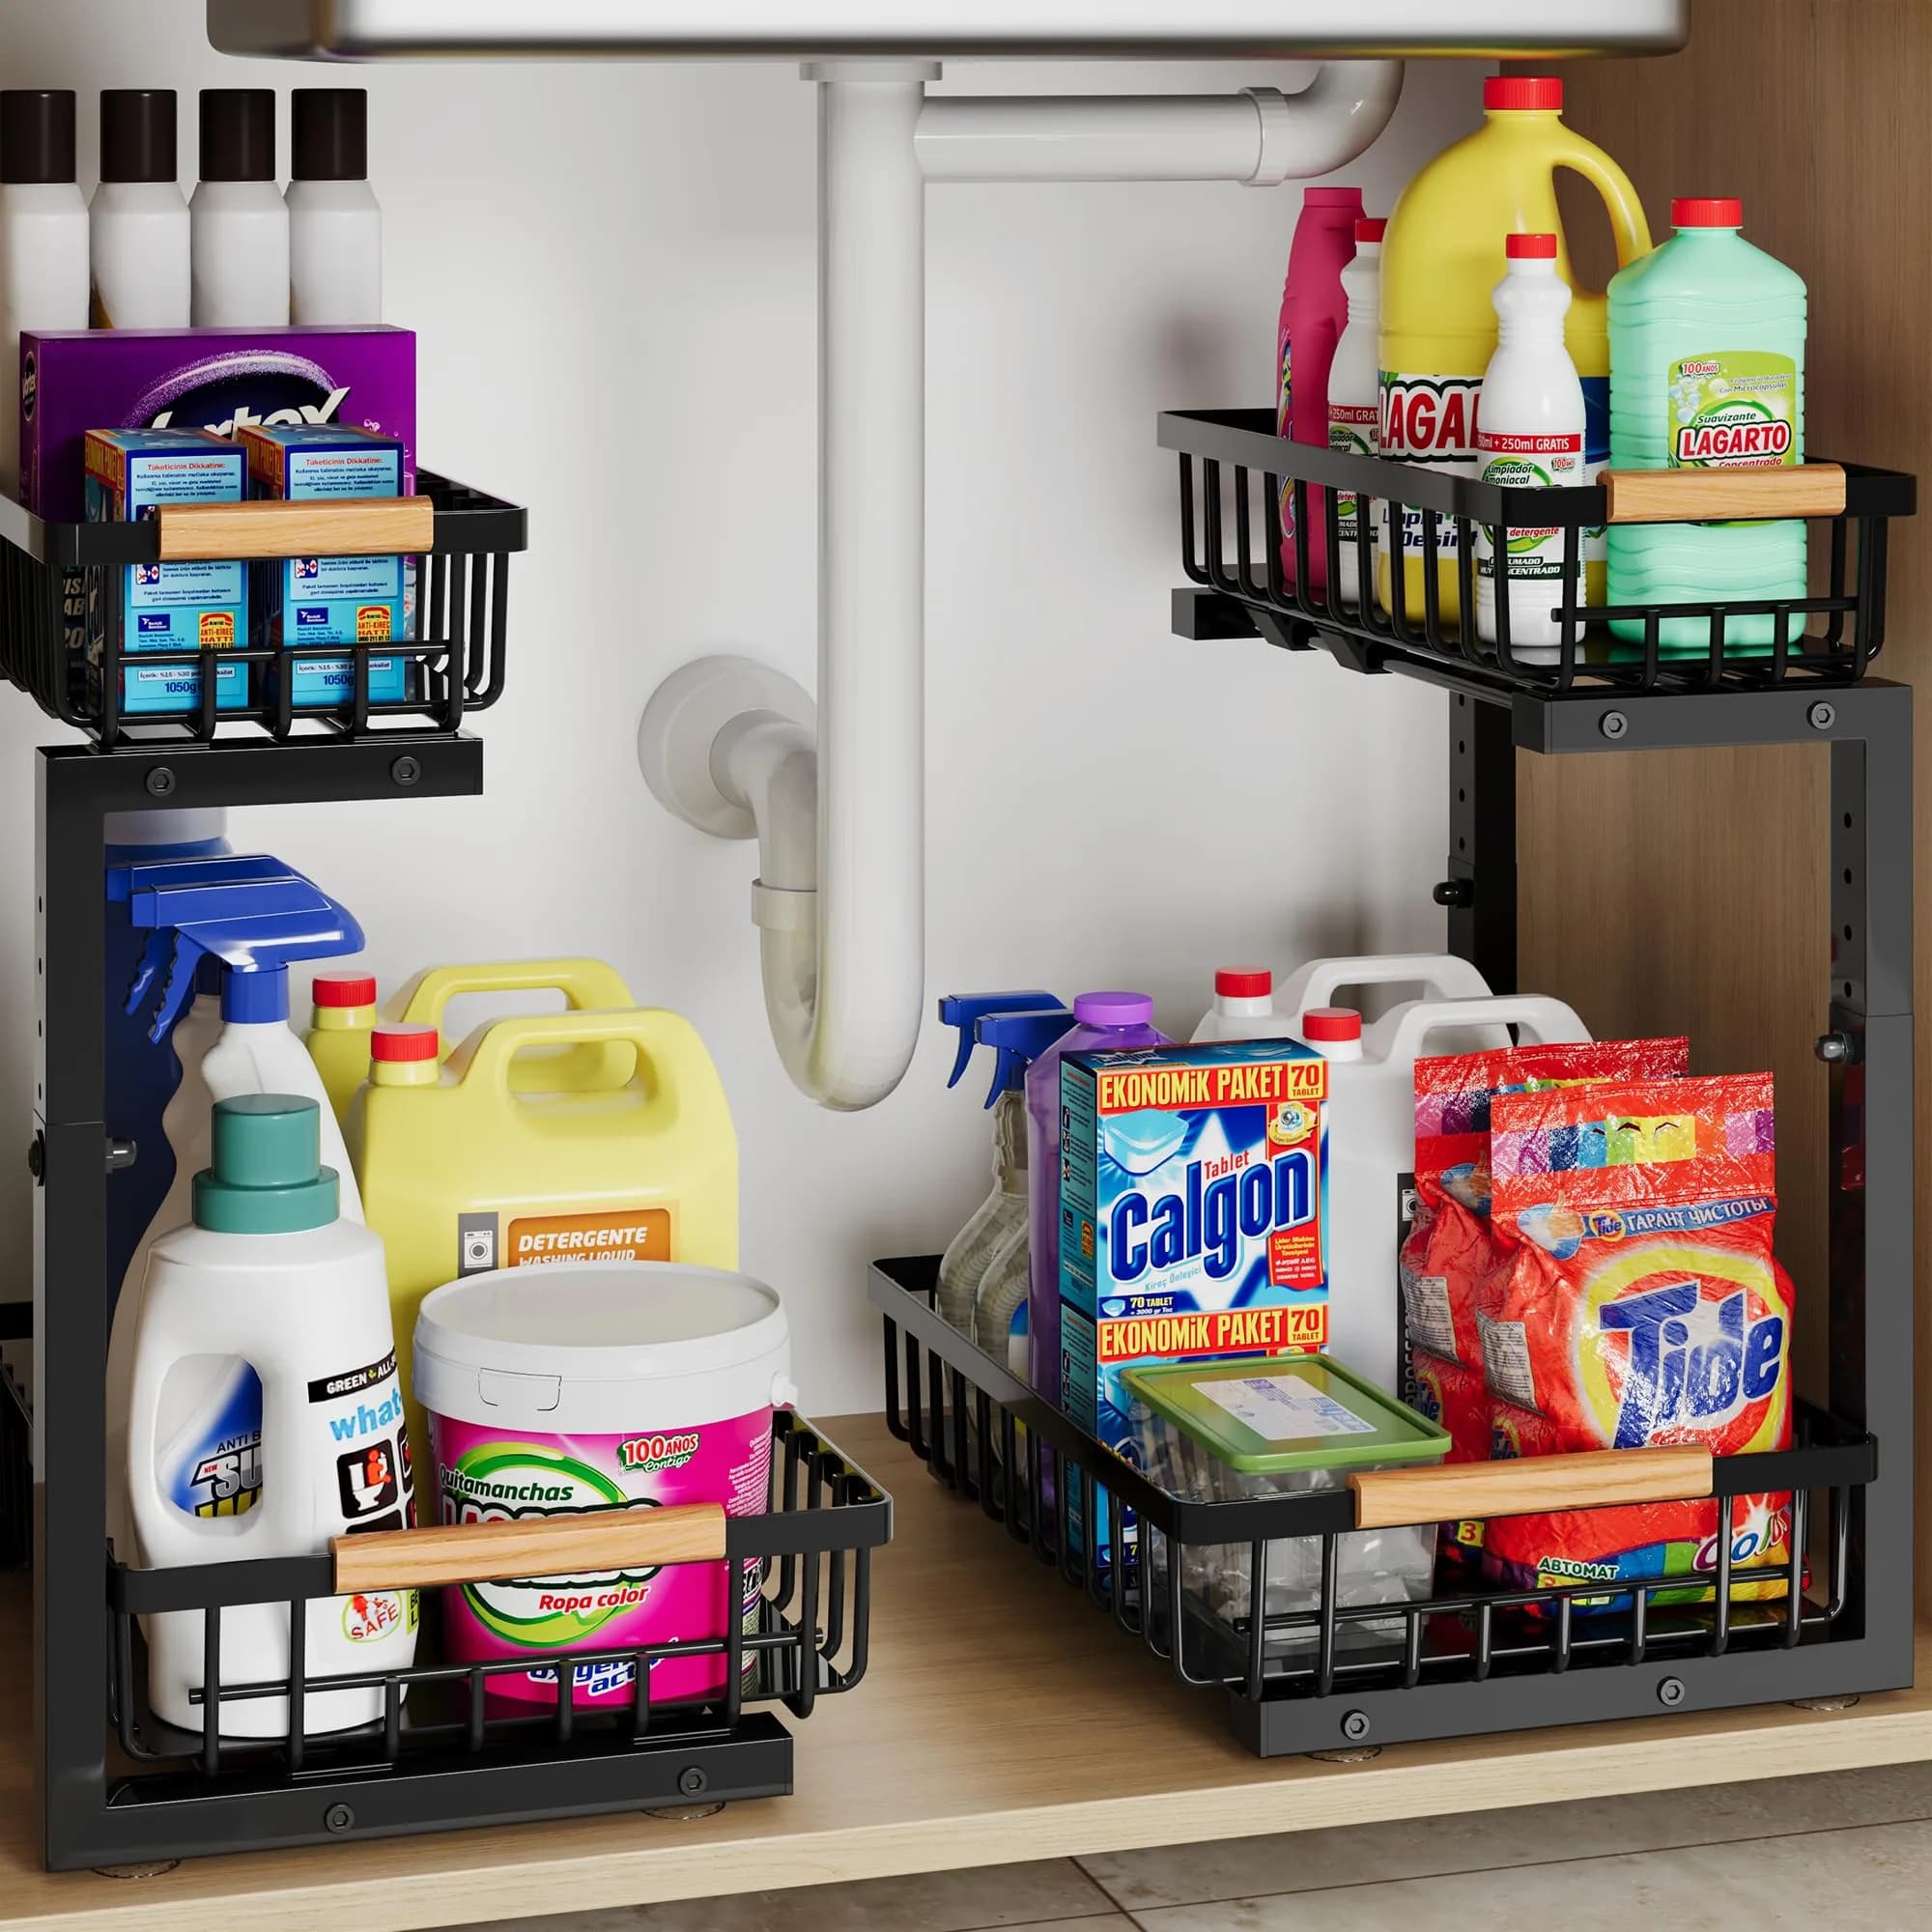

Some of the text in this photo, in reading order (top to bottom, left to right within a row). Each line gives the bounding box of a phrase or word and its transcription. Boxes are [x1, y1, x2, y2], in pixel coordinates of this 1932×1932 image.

[1684, 363, 1701, 374] 100
[1697, 412, 1756, 424] Suavizante
[1501, 438, 1534, 450] 250ml
[1536, 438, 1570, 450] GRATIS
[1684, 425, 1786, 456] LAGARTO
[1488, 464, 1533, 475] Limpiador
[1510, 527, 1560, 538] detergente
[165, 681, 197, 695] 1050g
[1217, 1065, 1284, 1101] PAKET
[1292, 1064, 1320, 1087] 70
[1292, 1088, 1321, 1097] TABLET
[1204, 1151, 1250, 1179] Tablet
[1111, 1151, 1309, 1281] Calgon
[1627, 1197, 1769, 1231] ГАРАНТ ЧИСТОТЫ
[1593, 1215, 1622, 1237] Tide
[518, 1227, 648, 1253] DETERGENTE
[519, 1252, 586, 1267] WASHING
[1145, 1278, 1168, 1292] Kireç
[1130, 1296, 1174, 1308] 70 TABLET
[1217, 1310, 1284, 1348] PAKET
[1292, 1309, 1320, 1332] 70
[1292, 1332, 1321, 1342] TABLET
[1600, 1282, 1783, 1449] Tide
[327, 1372, 368, 1394] GREEN
[216, 1434, 248, 1454] ANTI
[625, 1435, 696, 1463] 100 AÑOS
[204, 1464, 218, 1474] NEW
[643, 1455, 691, 1472] Contigo
[440, 1465, 574, 1501] Quitamanchas
[539, 1587, 649, 1612] Ropa color
[351, 1603, 399, 1639] SAFE
